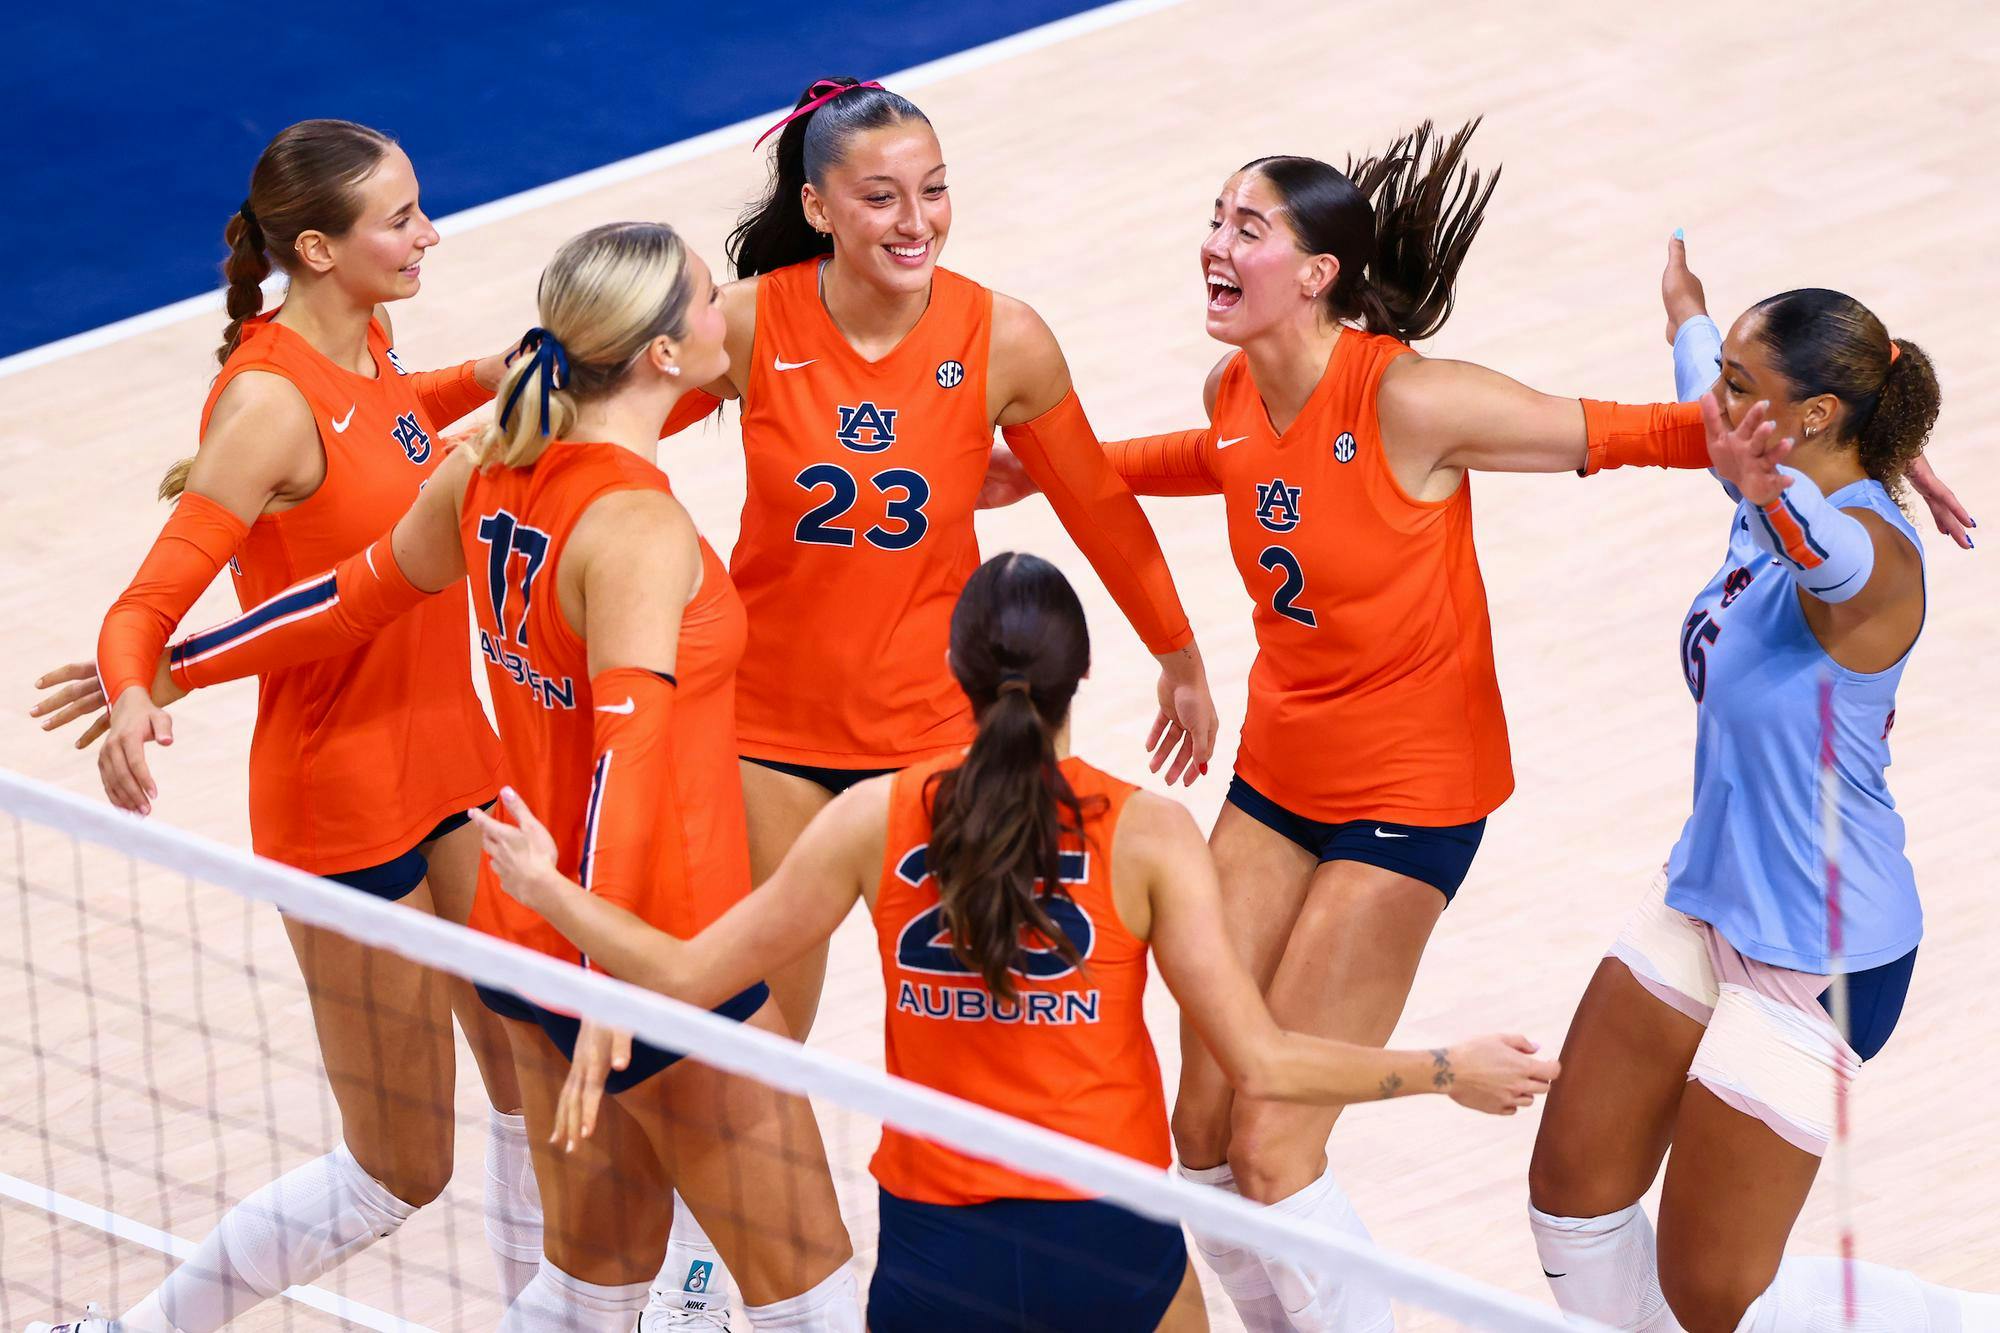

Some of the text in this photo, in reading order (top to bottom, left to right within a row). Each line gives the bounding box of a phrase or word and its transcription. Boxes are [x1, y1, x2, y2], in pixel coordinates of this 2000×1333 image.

[936, 360, 964, 388] SEC
[1334, 432, 1357, 463] SEC
[794, 463, 931, 550] 23
[477, 508, 551, 648] 17
[1258, 545, 1318, 628] 2
[1682, 608, 1722, 704] 15
[896, 979, 1100, 1026] AUBURN
[684, 1299, 707, 1311] NIKE
